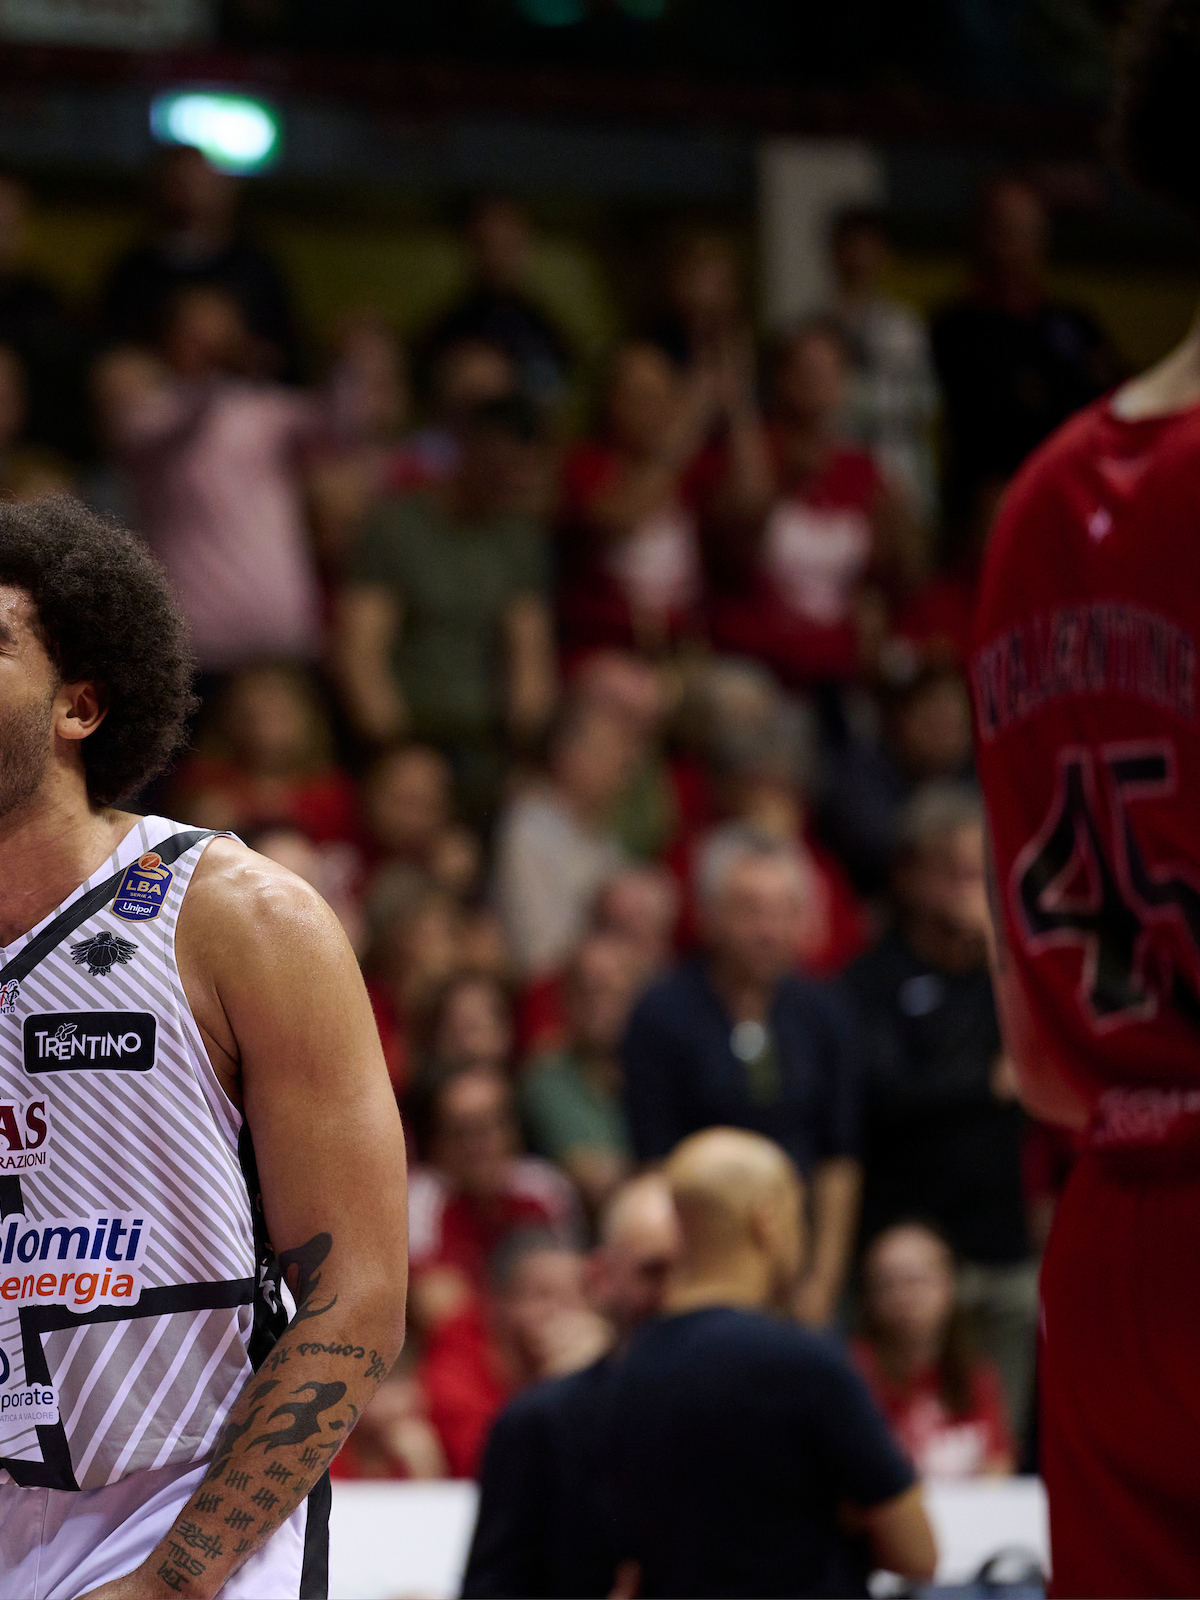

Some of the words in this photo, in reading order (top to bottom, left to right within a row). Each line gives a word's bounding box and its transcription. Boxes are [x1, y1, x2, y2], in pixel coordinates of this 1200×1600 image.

[126, 880, 161, 895] LBA
[123, 902, 153, 915] Unipol
[35, 1031, 142, 1060] TRENTINO
[296, 1342, 366, 1359] comes
[23, 1411, 54, 1420] VALORE
